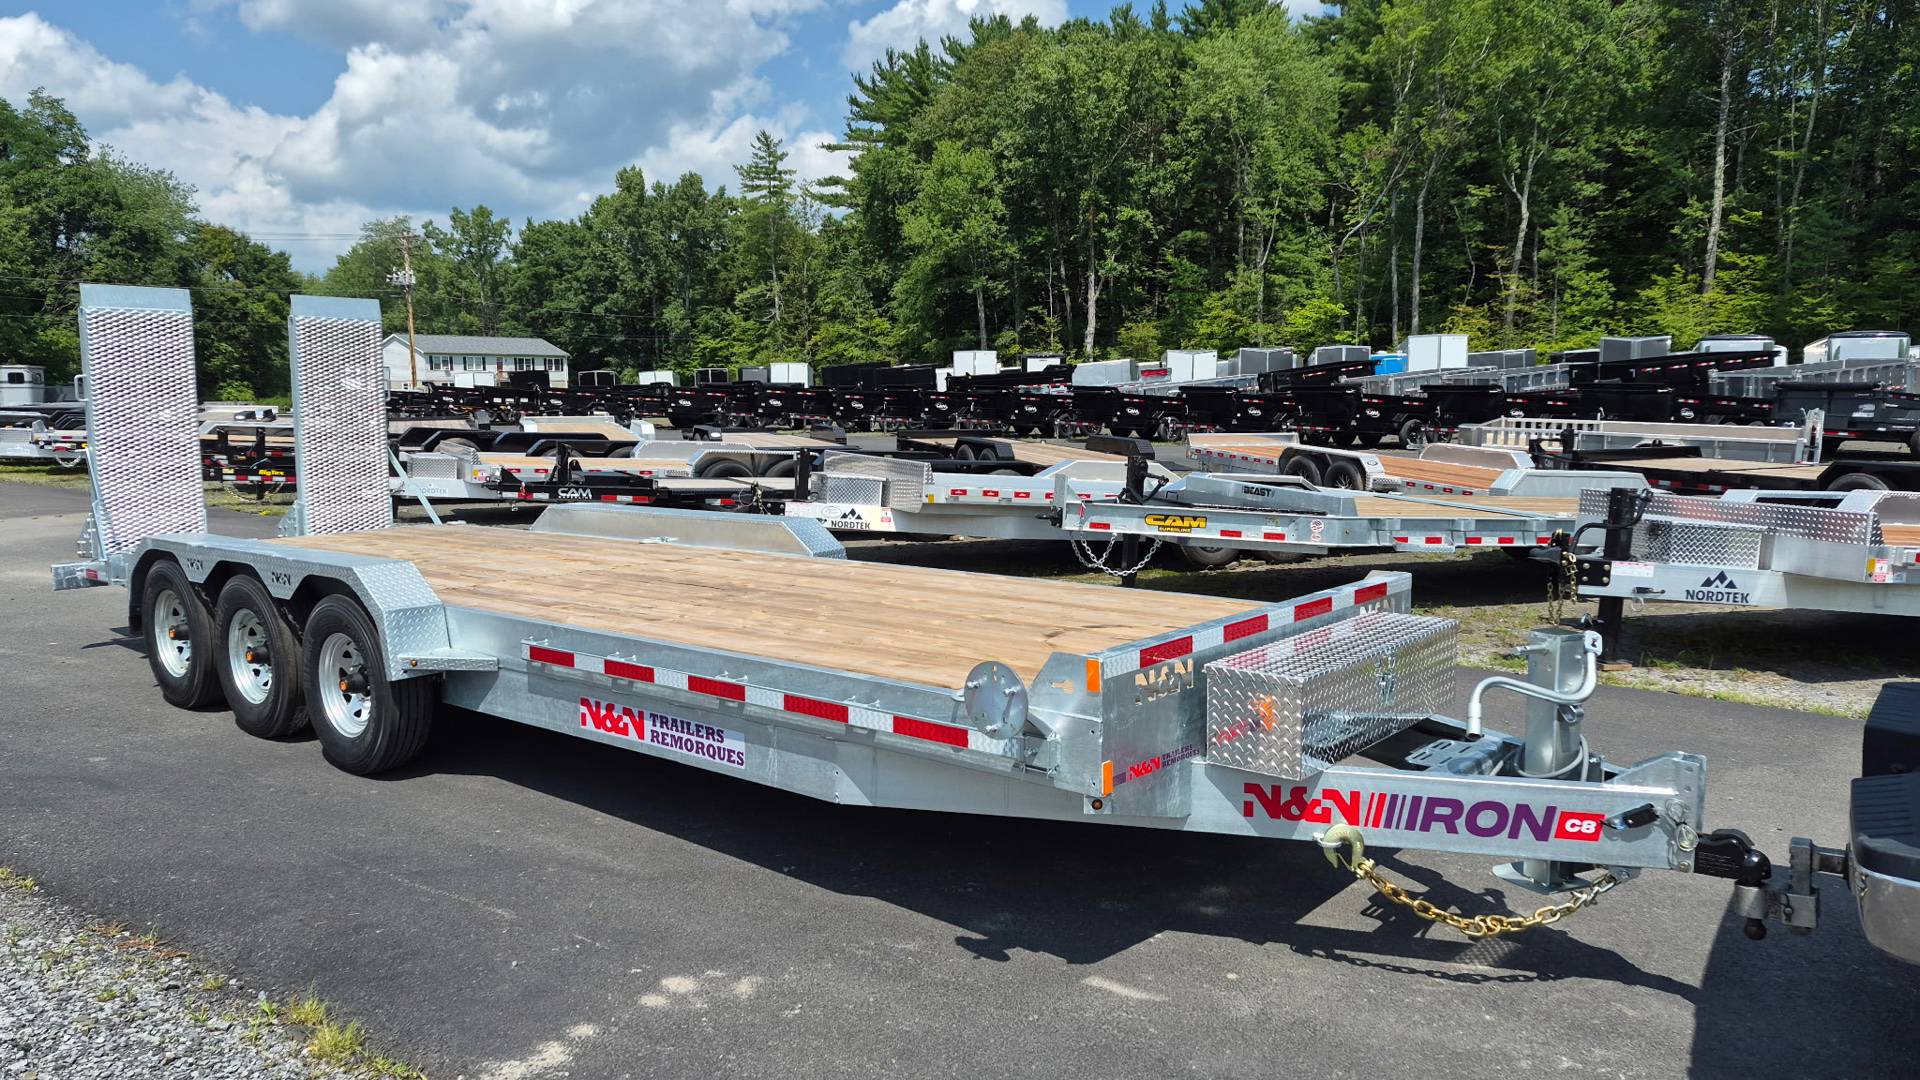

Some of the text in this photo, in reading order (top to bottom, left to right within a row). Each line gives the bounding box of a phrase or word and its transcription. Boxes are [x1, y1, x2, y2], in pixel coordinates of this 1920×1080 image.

[419, 487, 448, 495] ORDTEK
[557, 487, 592, 499] CAM
[1243, 485, 1272, 498] BEAST
[831, 520, 871, 530] NORDTEK
[1145, 514, 1207, 529] CAM
[1685, 589, 1750, 604] NORDTEK
[580, 697, 725, 744] N&N TRAILERS
[650, 729, 745, 767] REMORQUES
[1129, 756, 1161, 781] N&N
[1243, 782, 1596, 842] N&N IRON C8
